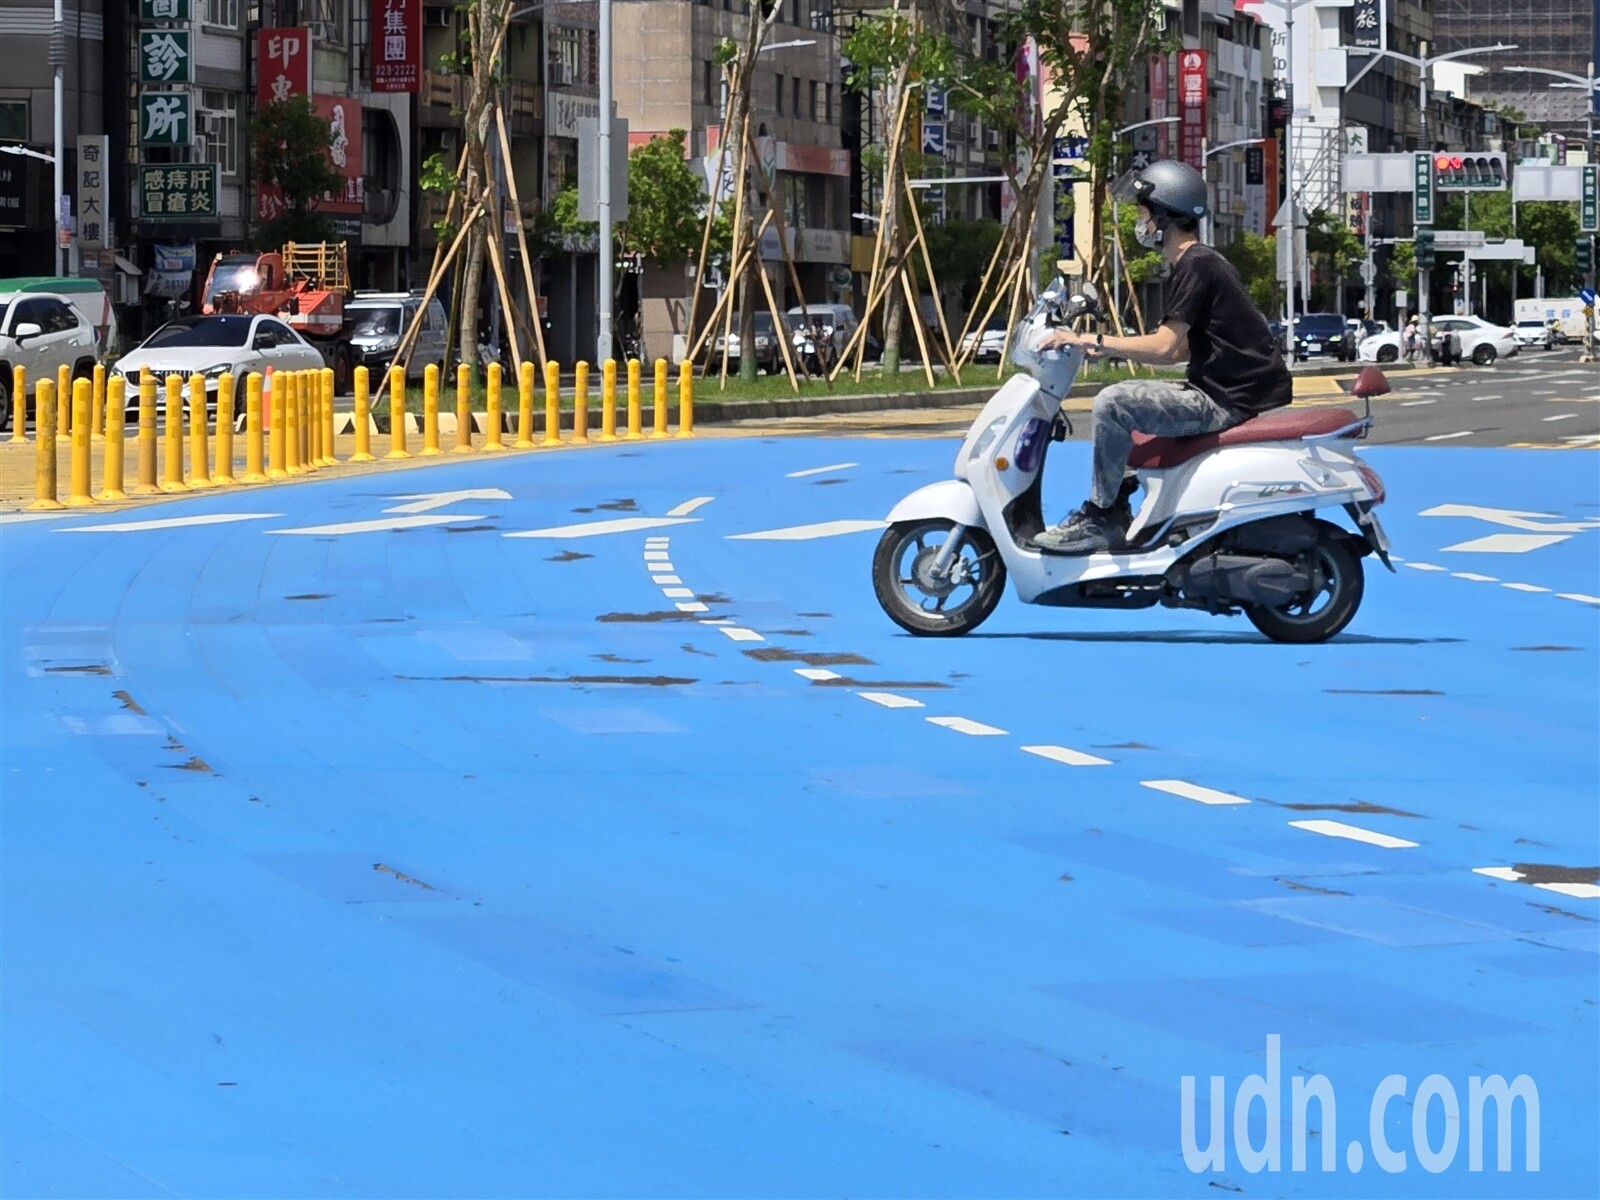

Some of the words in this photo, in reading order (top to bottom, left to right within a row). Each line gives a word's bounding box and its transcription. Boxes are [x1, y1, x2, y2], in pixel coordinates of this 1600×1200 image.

[1352, 0, 1378, 28] 旅
[83, 144, 100, 241] 奇記大樓
